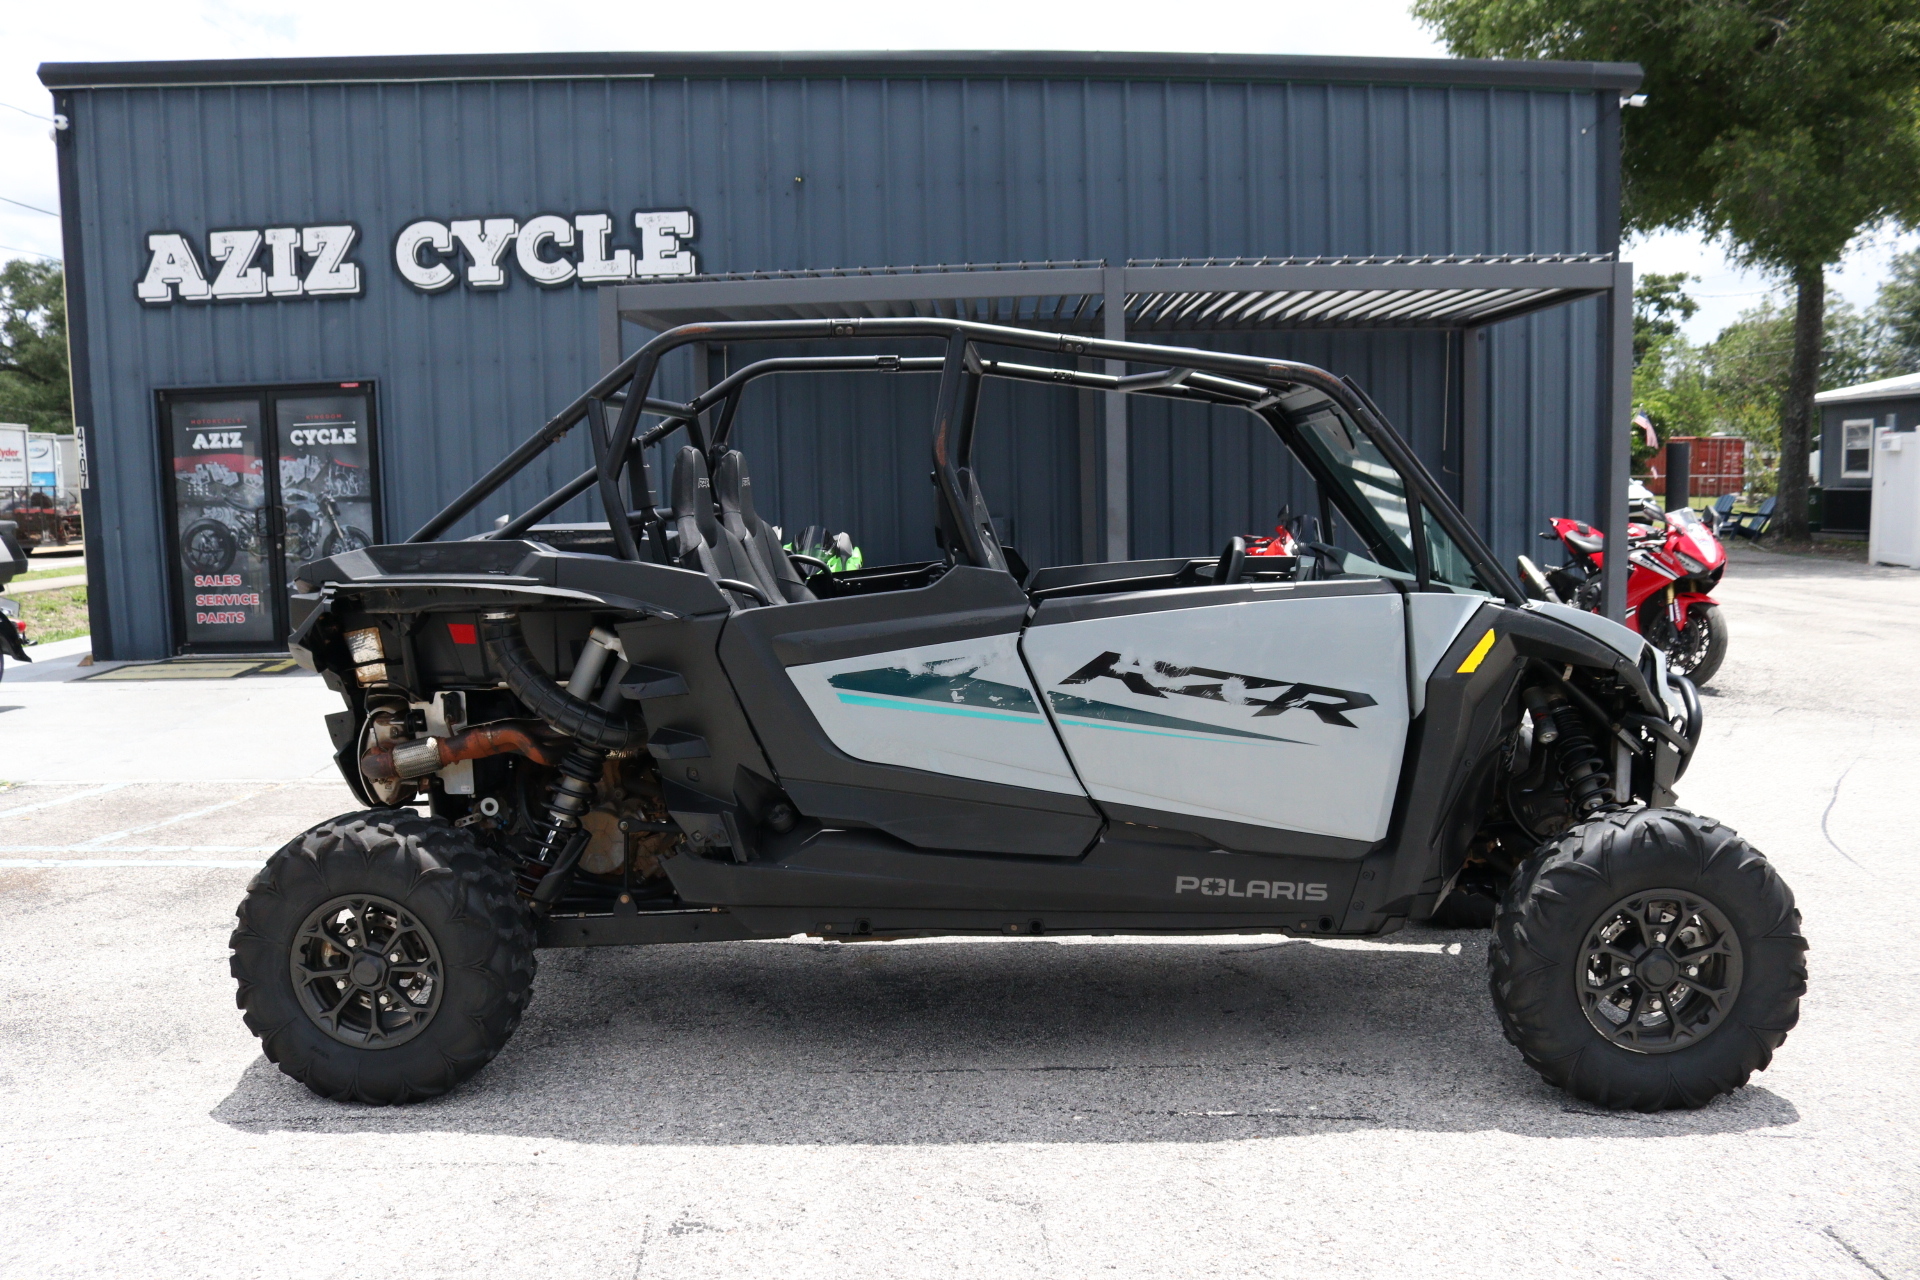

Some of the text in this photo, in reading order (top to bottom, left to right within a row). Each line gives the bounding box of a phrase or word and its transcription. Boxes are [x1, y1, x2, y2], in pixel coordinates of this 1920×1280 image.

[138, 211, 696, 301] AZIZ CYCLE
[192, 428, 357, 449] AZIZ CYCLE
[194, 574, 242, 587] SALES
[196, 593, 260, 606] SERVICE
[197, 612, 245, 624] PARTS
[1175, 875, 1328, 901] POLARIS
